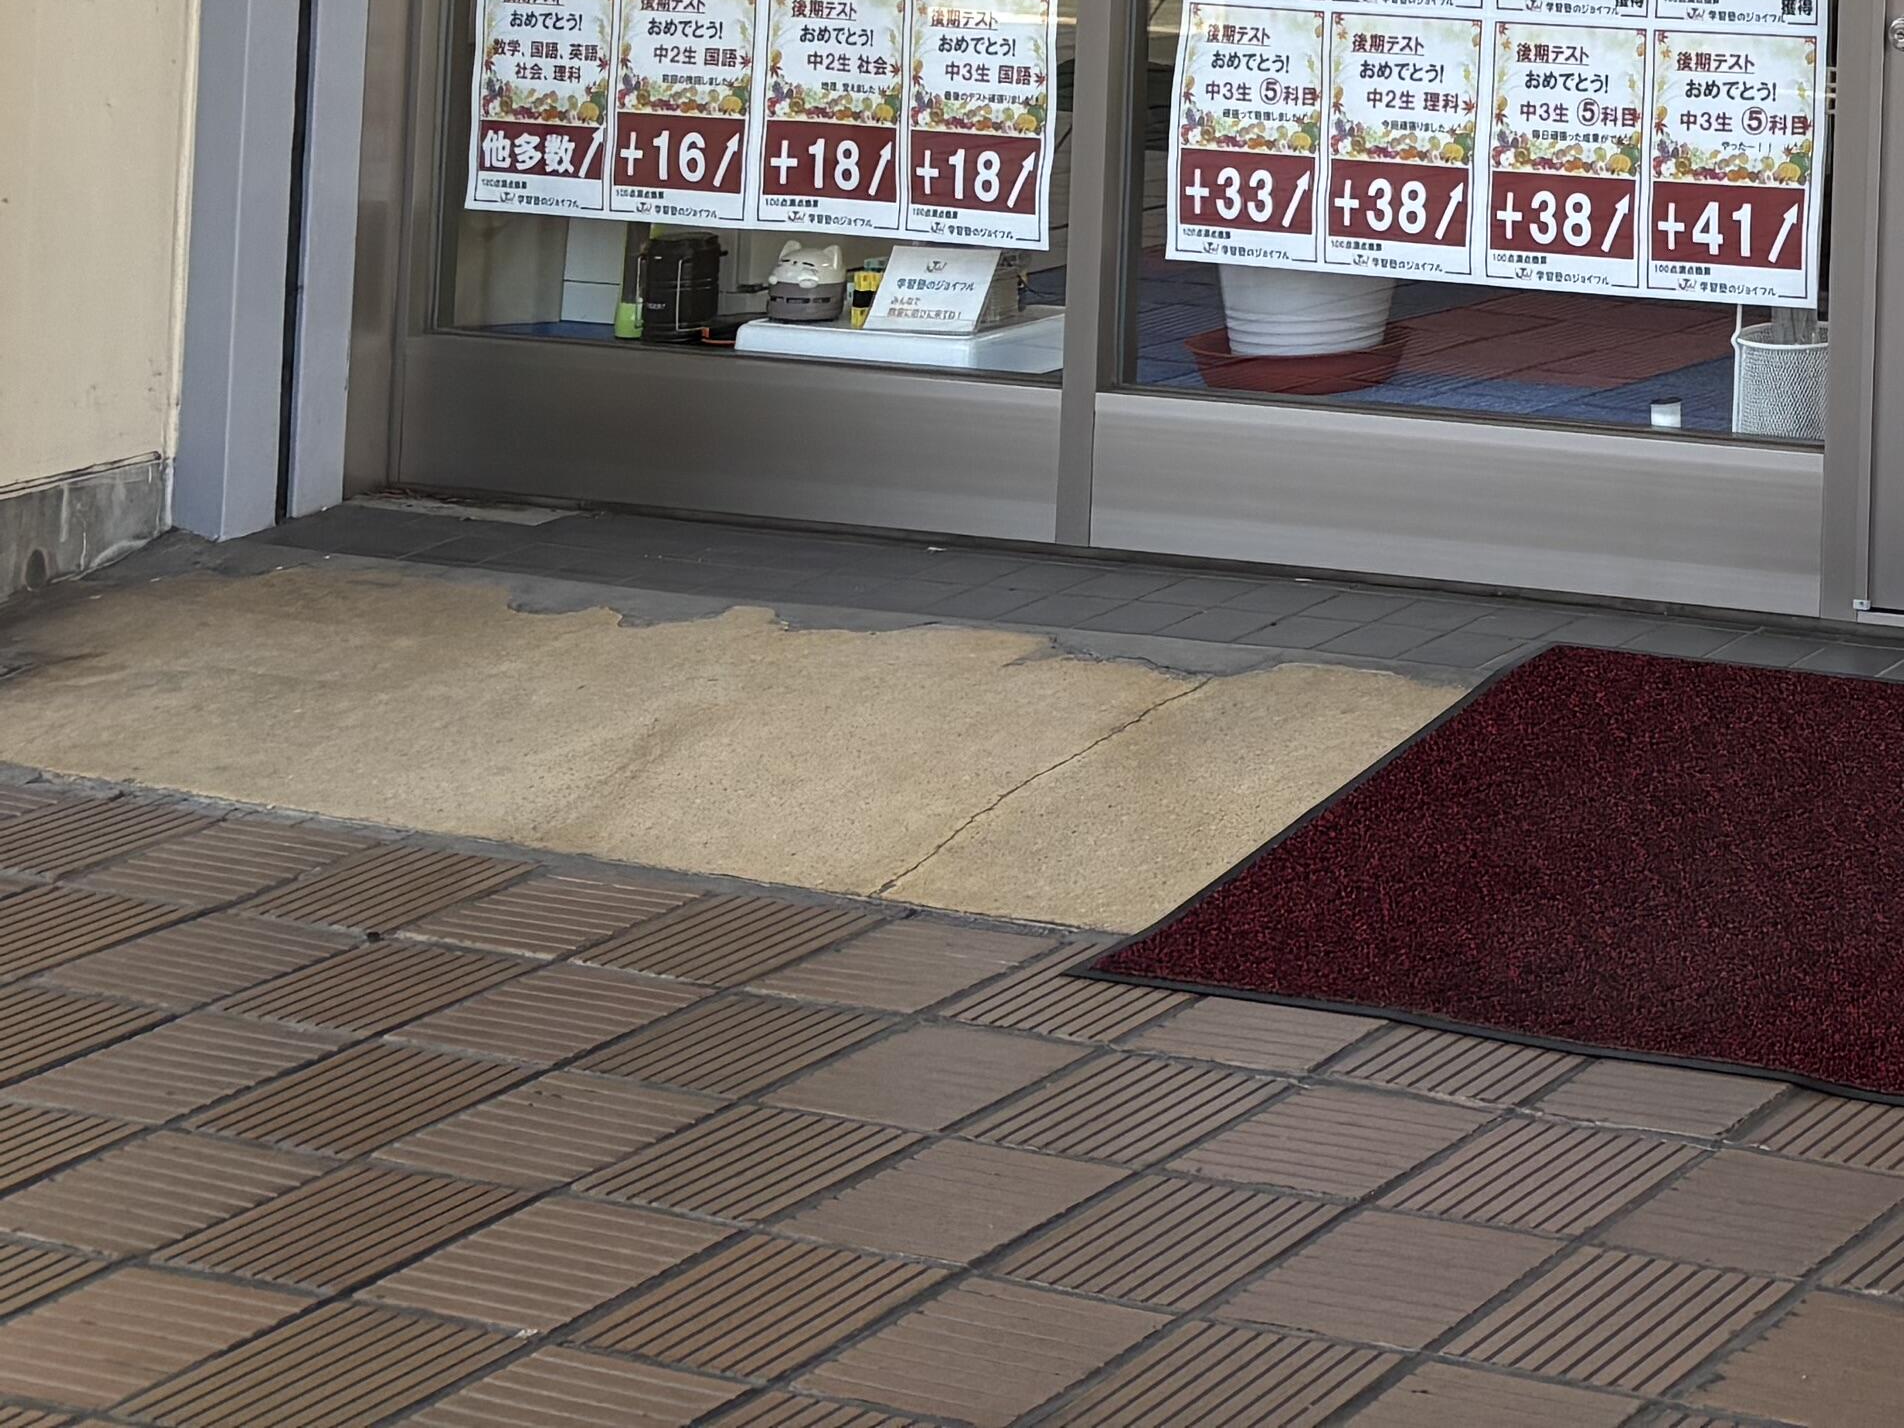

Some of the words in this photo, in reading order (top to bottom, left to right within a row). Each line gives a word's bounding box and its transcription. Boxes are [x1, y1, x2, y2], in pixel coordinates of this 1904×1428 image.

[482, 130, 575, 174] 他多数
[620, 129, 706, 182] +16
[771, 138, 860, 191] +18
[916, 148, 1000, 202] +18
[1185, 166, 1273, 221] +33
[1334, 178, 1427, 234] +38
[1497, 191, 1593, 247] +38
[1657, 201, 1751, 257] +41
